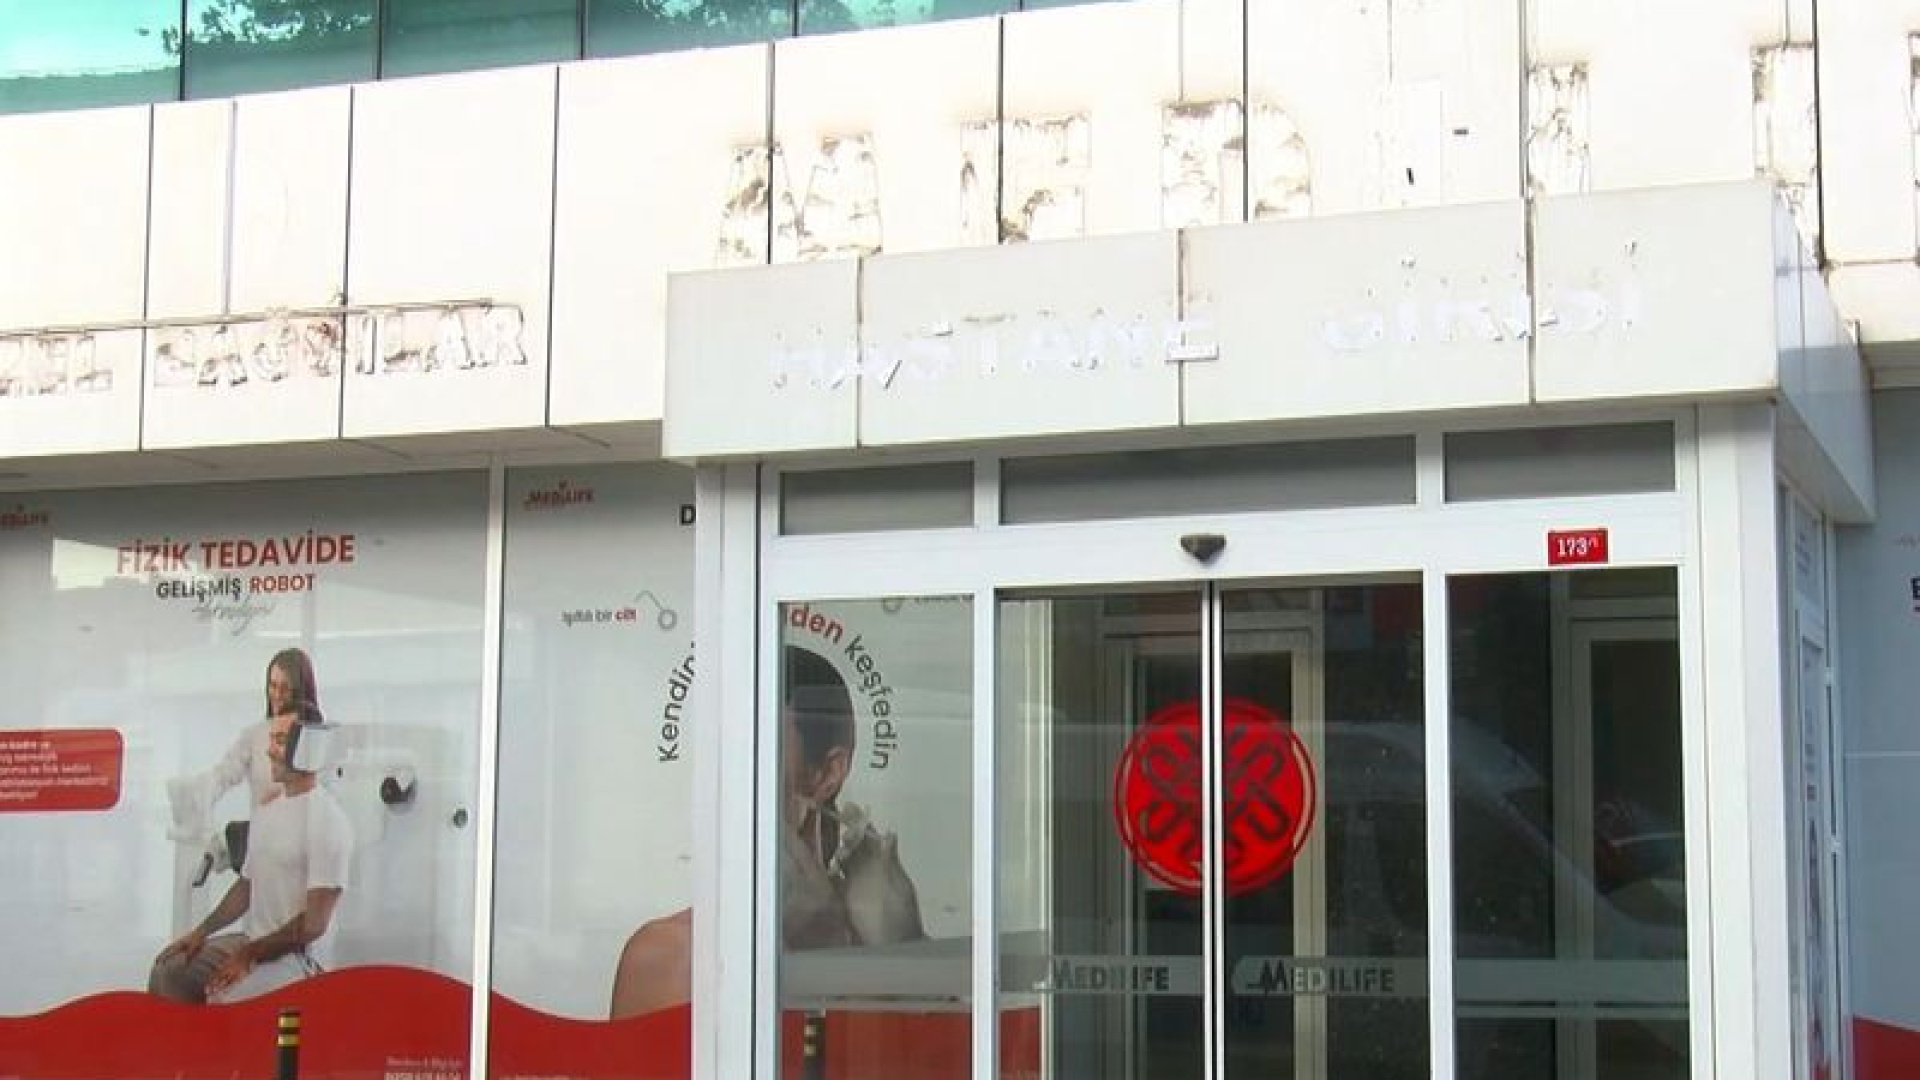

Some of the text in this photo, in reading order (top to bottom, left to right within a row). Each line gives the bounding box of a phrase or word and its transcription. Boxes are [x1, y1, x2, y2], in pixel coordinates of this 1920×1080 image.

[116, 529, 355, 574] FİZİK TEDAVİDE
[155, 573, 315, 602] GELİŞMİŞ ROBOT
[658, 641, 696, 763] Kendin
[844, 634, 898, 770] keşfedin
[1248, 959, 1395, 994] MEDILIFE
